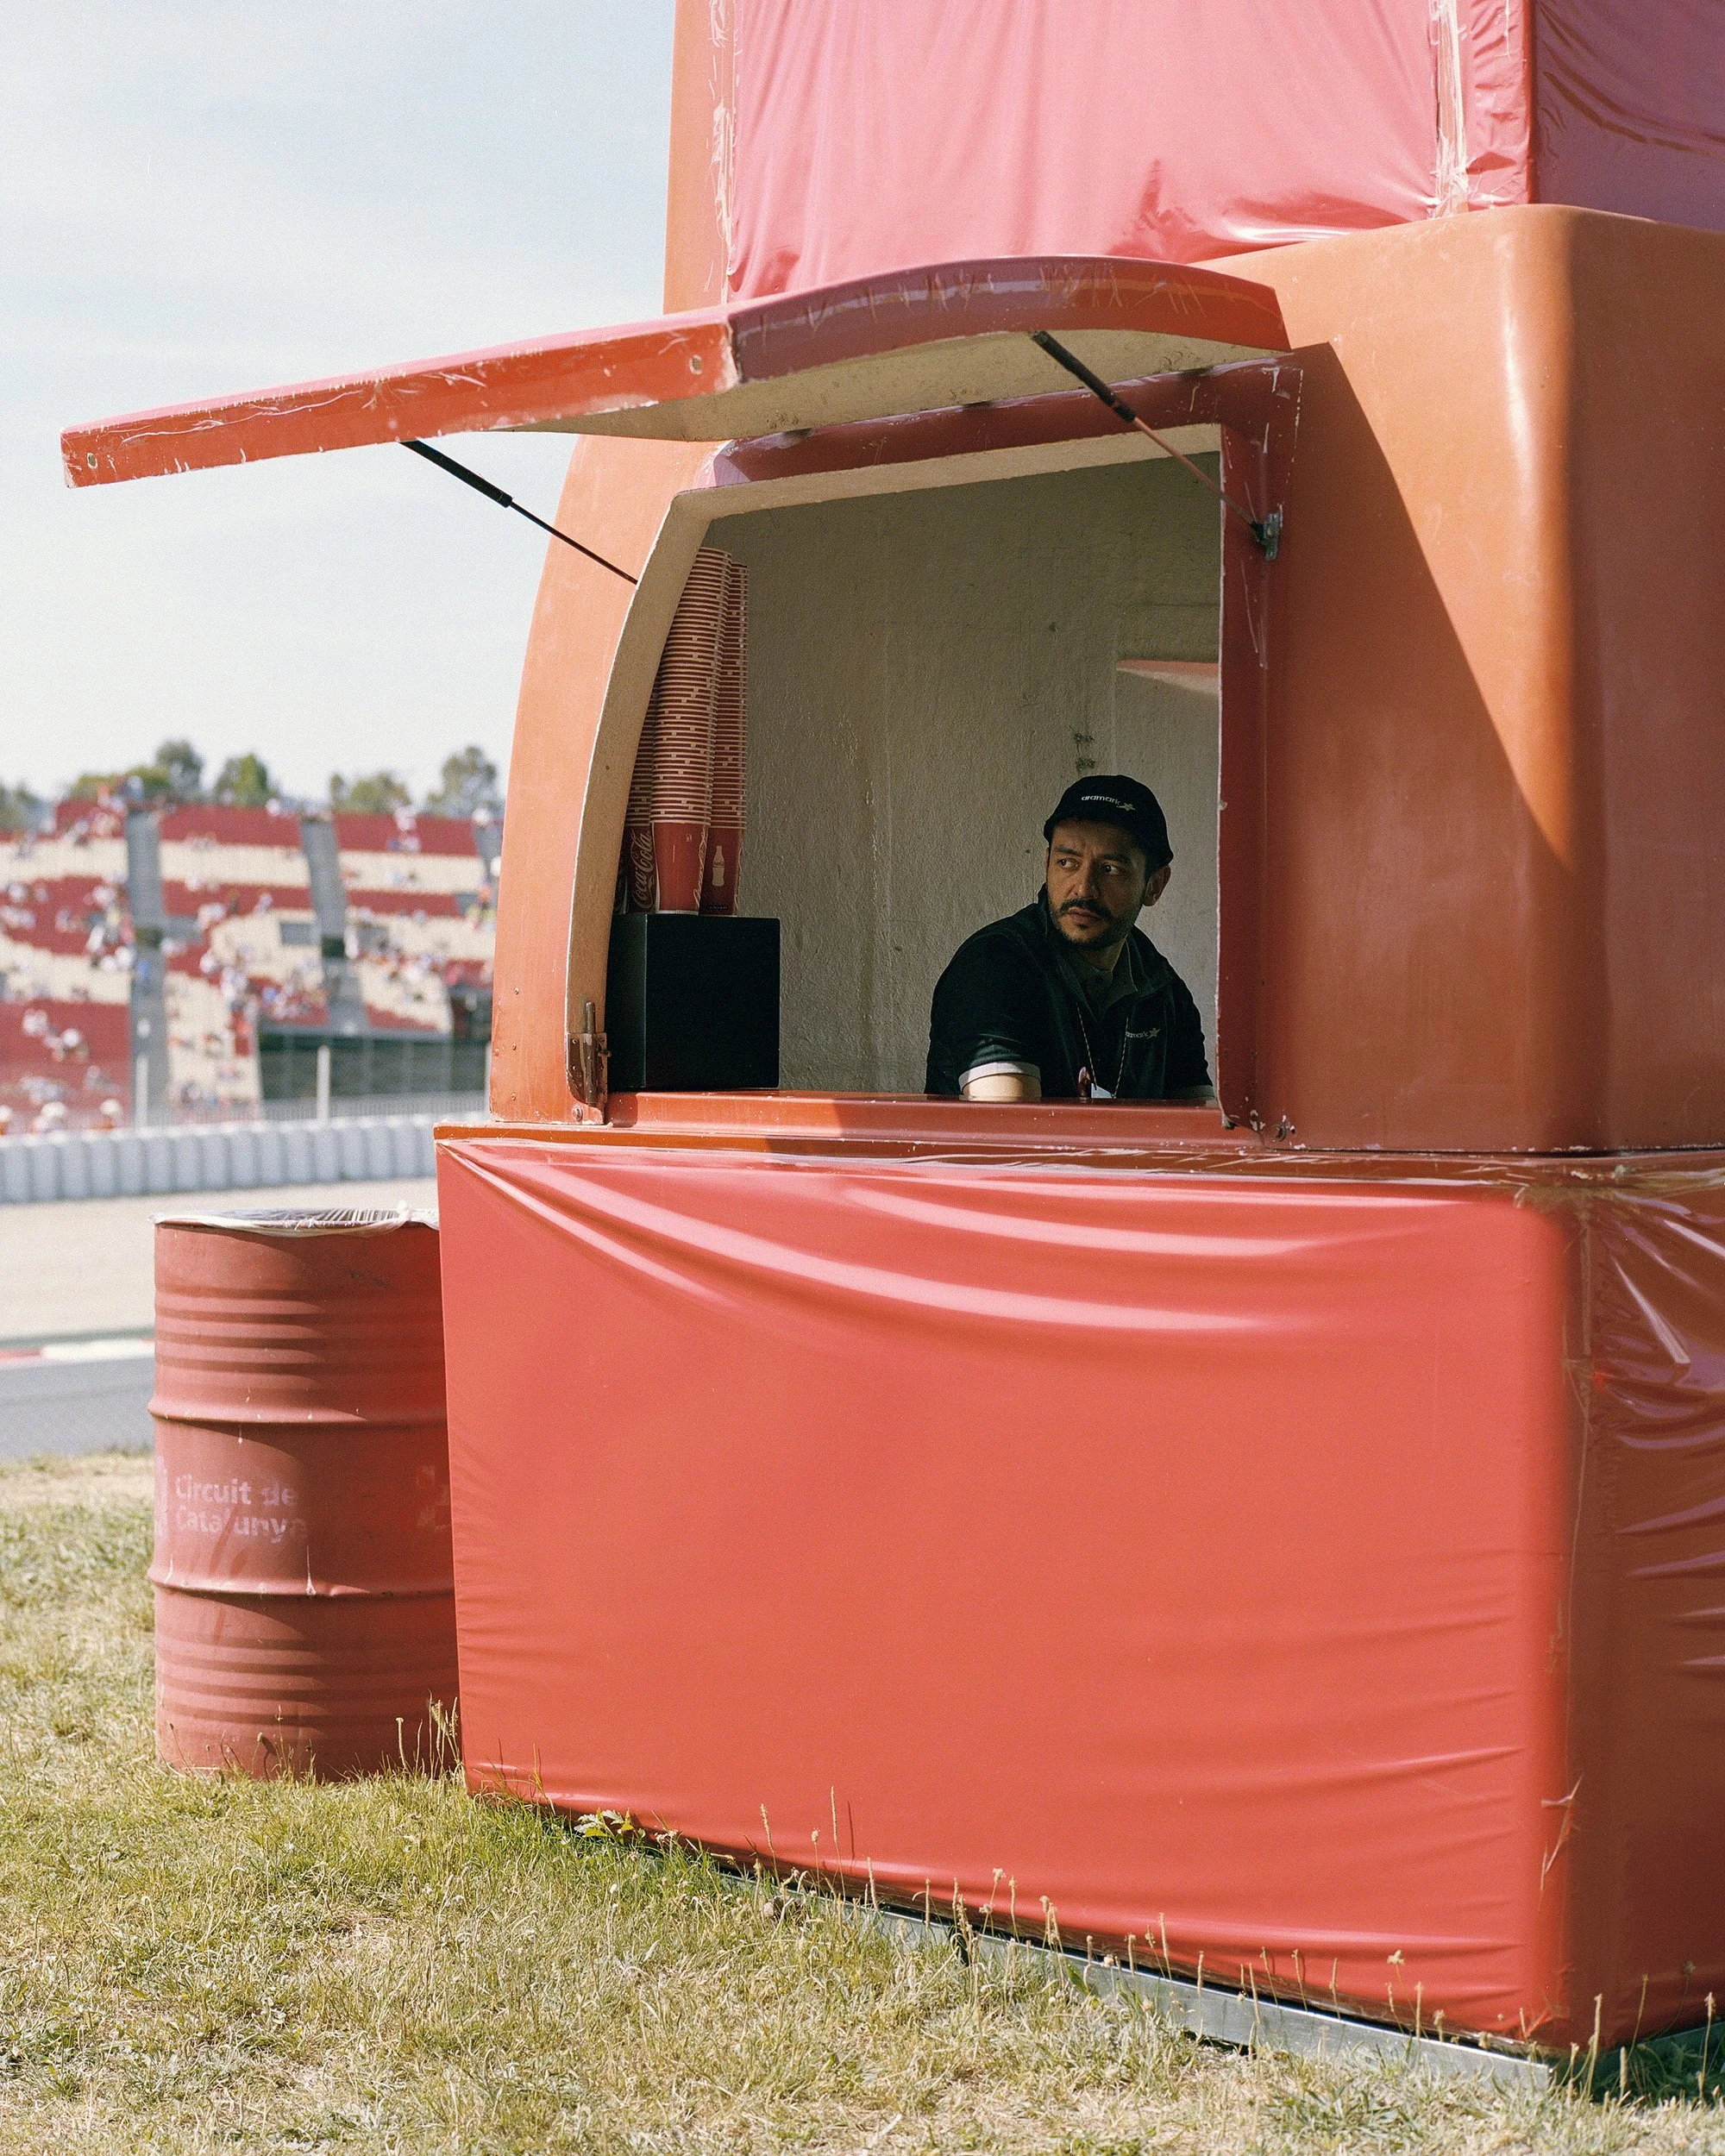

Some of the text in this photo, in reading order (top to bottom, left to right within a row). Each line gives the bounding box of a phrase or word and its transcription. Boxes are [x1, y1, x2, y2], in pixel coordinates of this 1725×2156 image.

[1081, 795, 1121, 806] aramark
[175, 1474, 300, 1507] Circuit de
